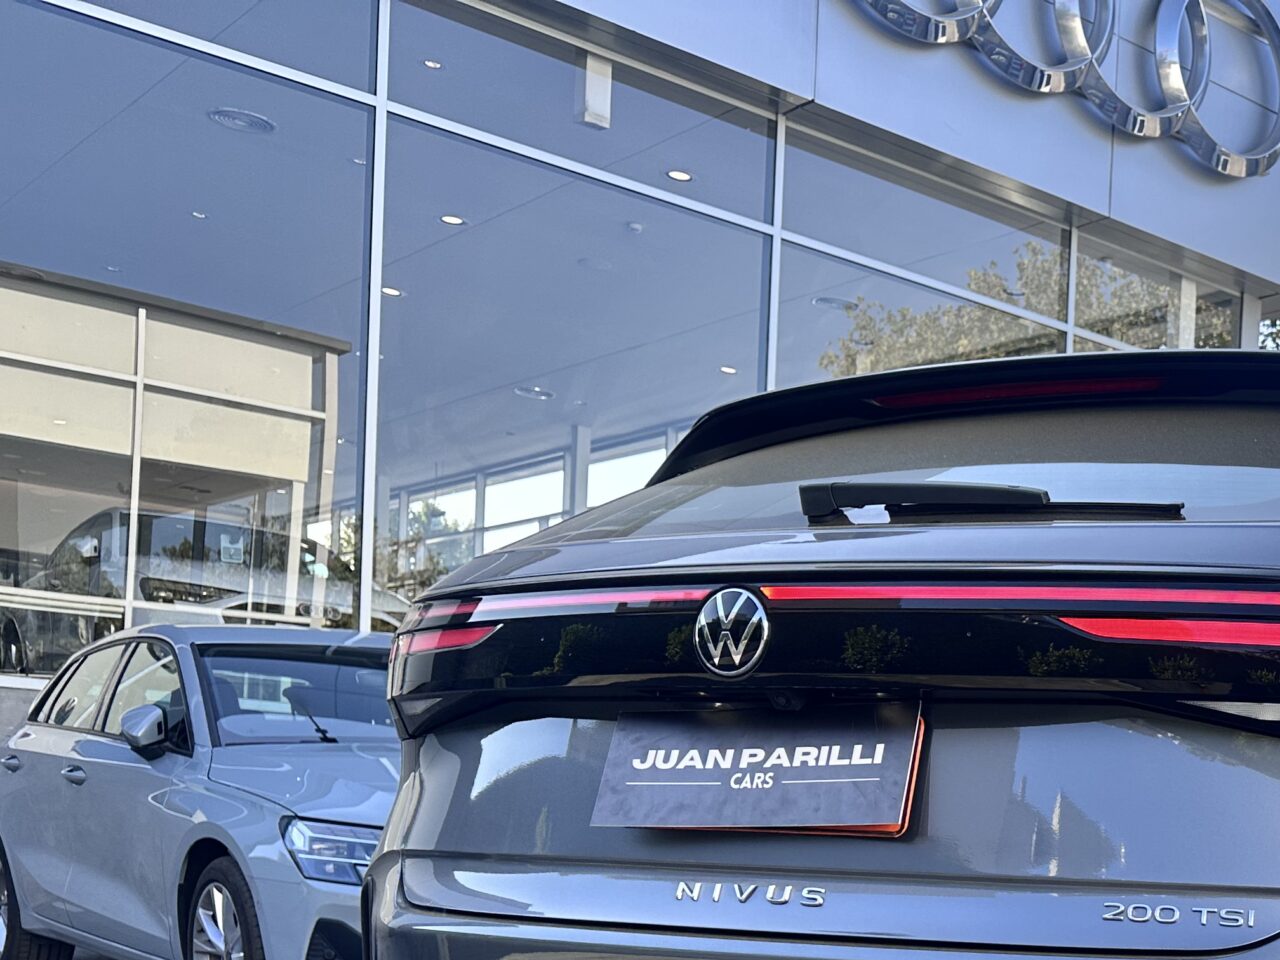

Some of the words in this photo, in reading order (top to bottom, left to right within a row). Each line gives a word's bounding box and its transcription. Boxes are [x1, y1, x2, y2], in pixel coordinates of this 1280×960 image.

[697, 588, 767, 674] VW
[632, 749, 735, 770] JUAN
[738, 743, 885, 768] PARILLI
[730, 772, 774, 789] CARS
[676, 881, 826, 907] NIVUS
[1102, 902, 1180, 924] 200
[1192, 907, 1255, 927] TSI
